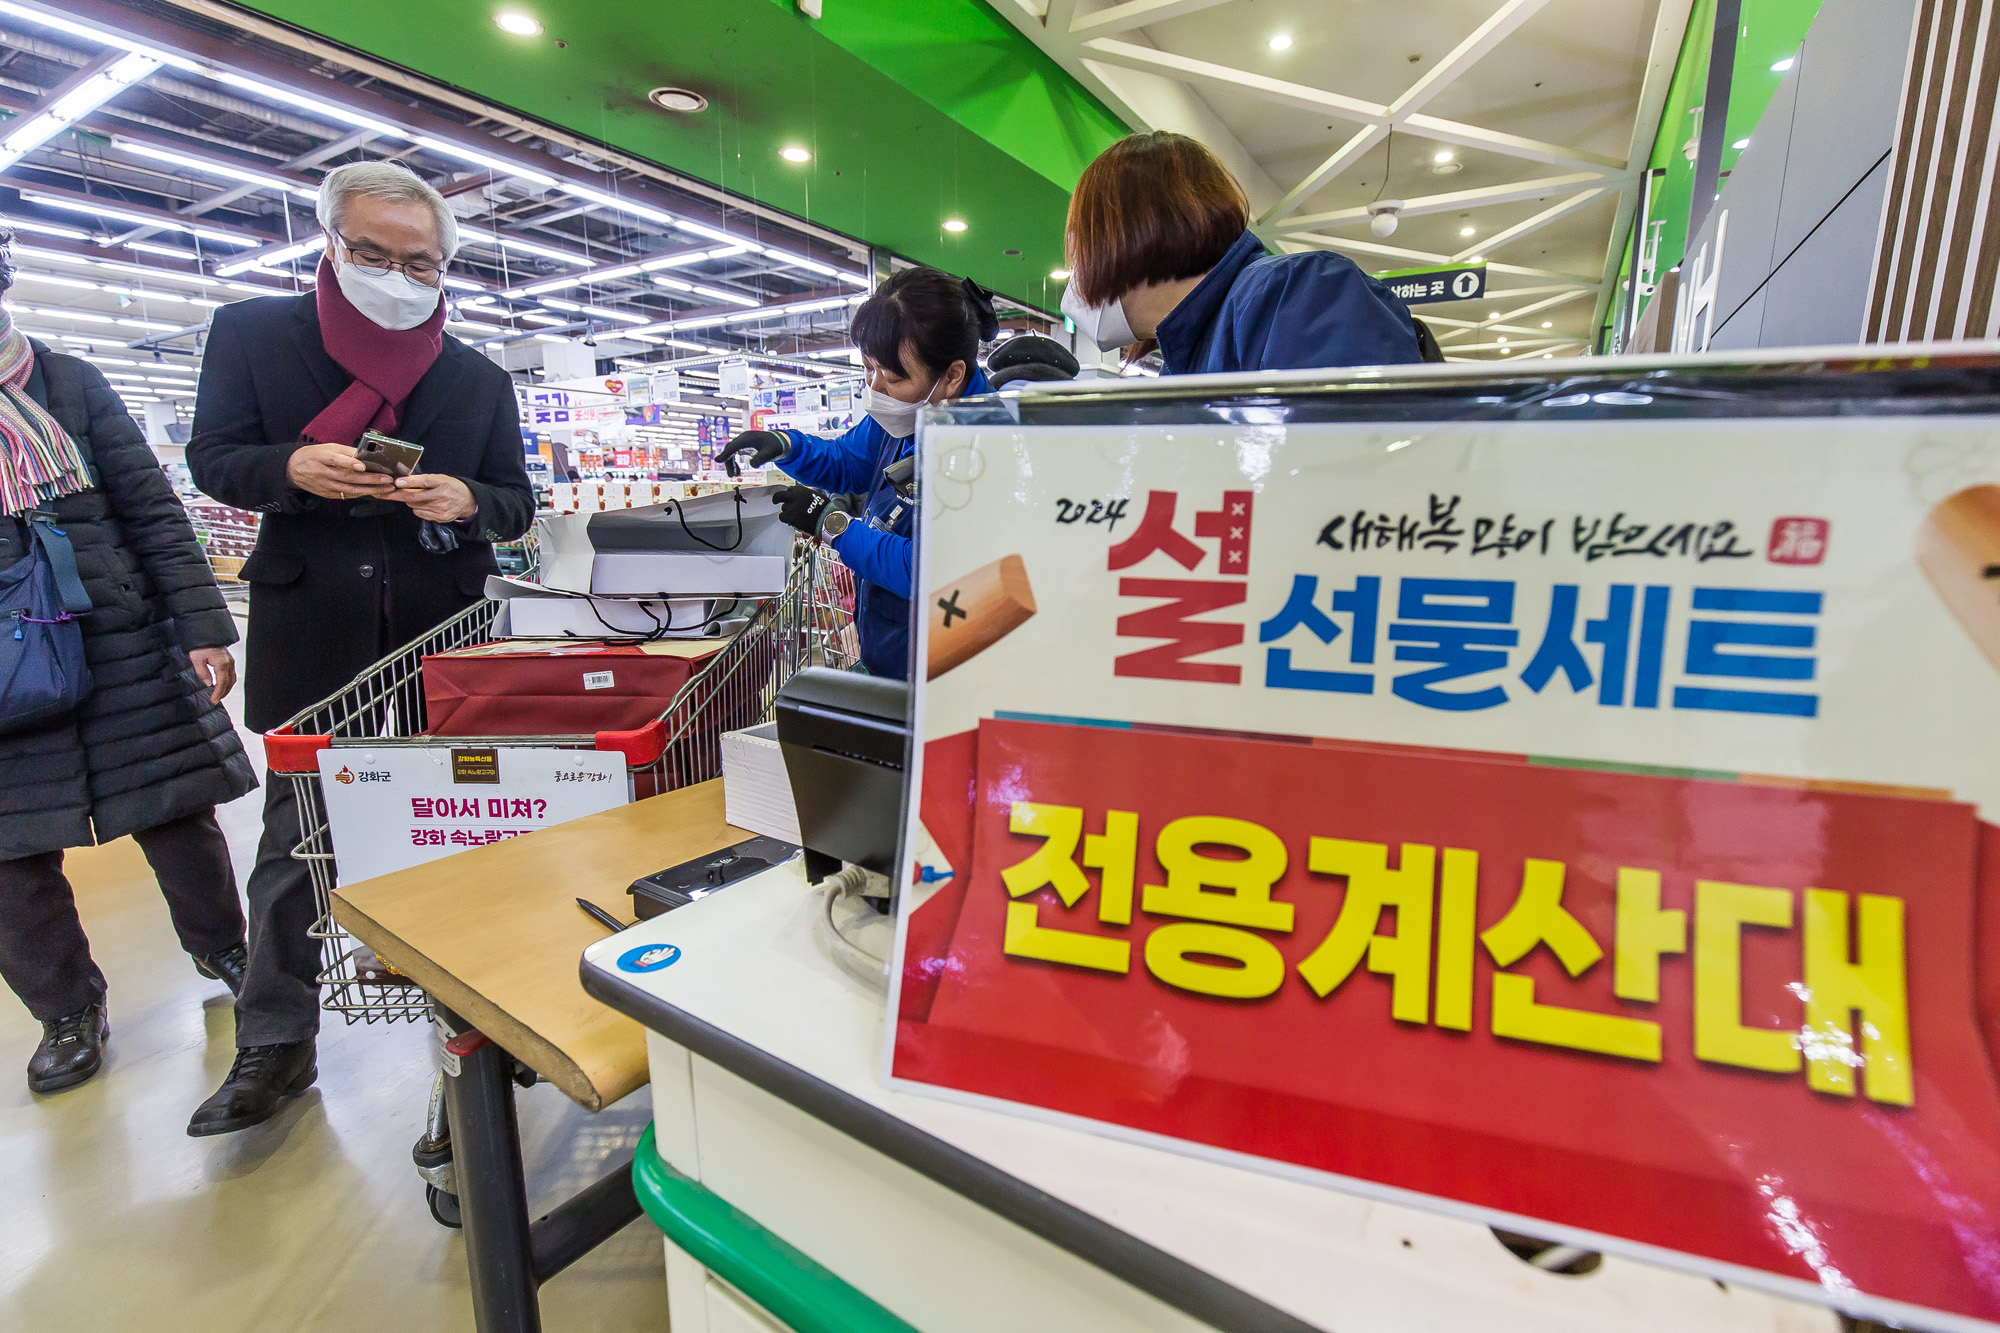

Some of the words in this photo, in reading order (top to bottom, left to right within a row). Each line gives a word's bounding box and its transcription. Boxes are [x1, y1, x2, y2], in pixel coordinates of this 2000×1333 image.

[1430, 280, 1444, 296] 곳
[753, 391, 773, 408] 선물
[1471, 511, 1557, 559] 많이
[1571, 511, 1755, 563] 받으세요
[1055, 497, 1132, 533] 2024
[1106, 489, 1255, 686] 설
[1258, 573, 1826, 719] 선물세트
[358, 771, 392, 782] 강화군
[553, 770, 585, 783] 풍요로운
[411, 797, 481, 819] 달아서
[487, 798, 548, 820] 미쳐?
[410, 829, 447, 846] 강화
[450, 829, 534, 846] 속노랑고
[1000, 799, 1917, 1107] 전용계산대
